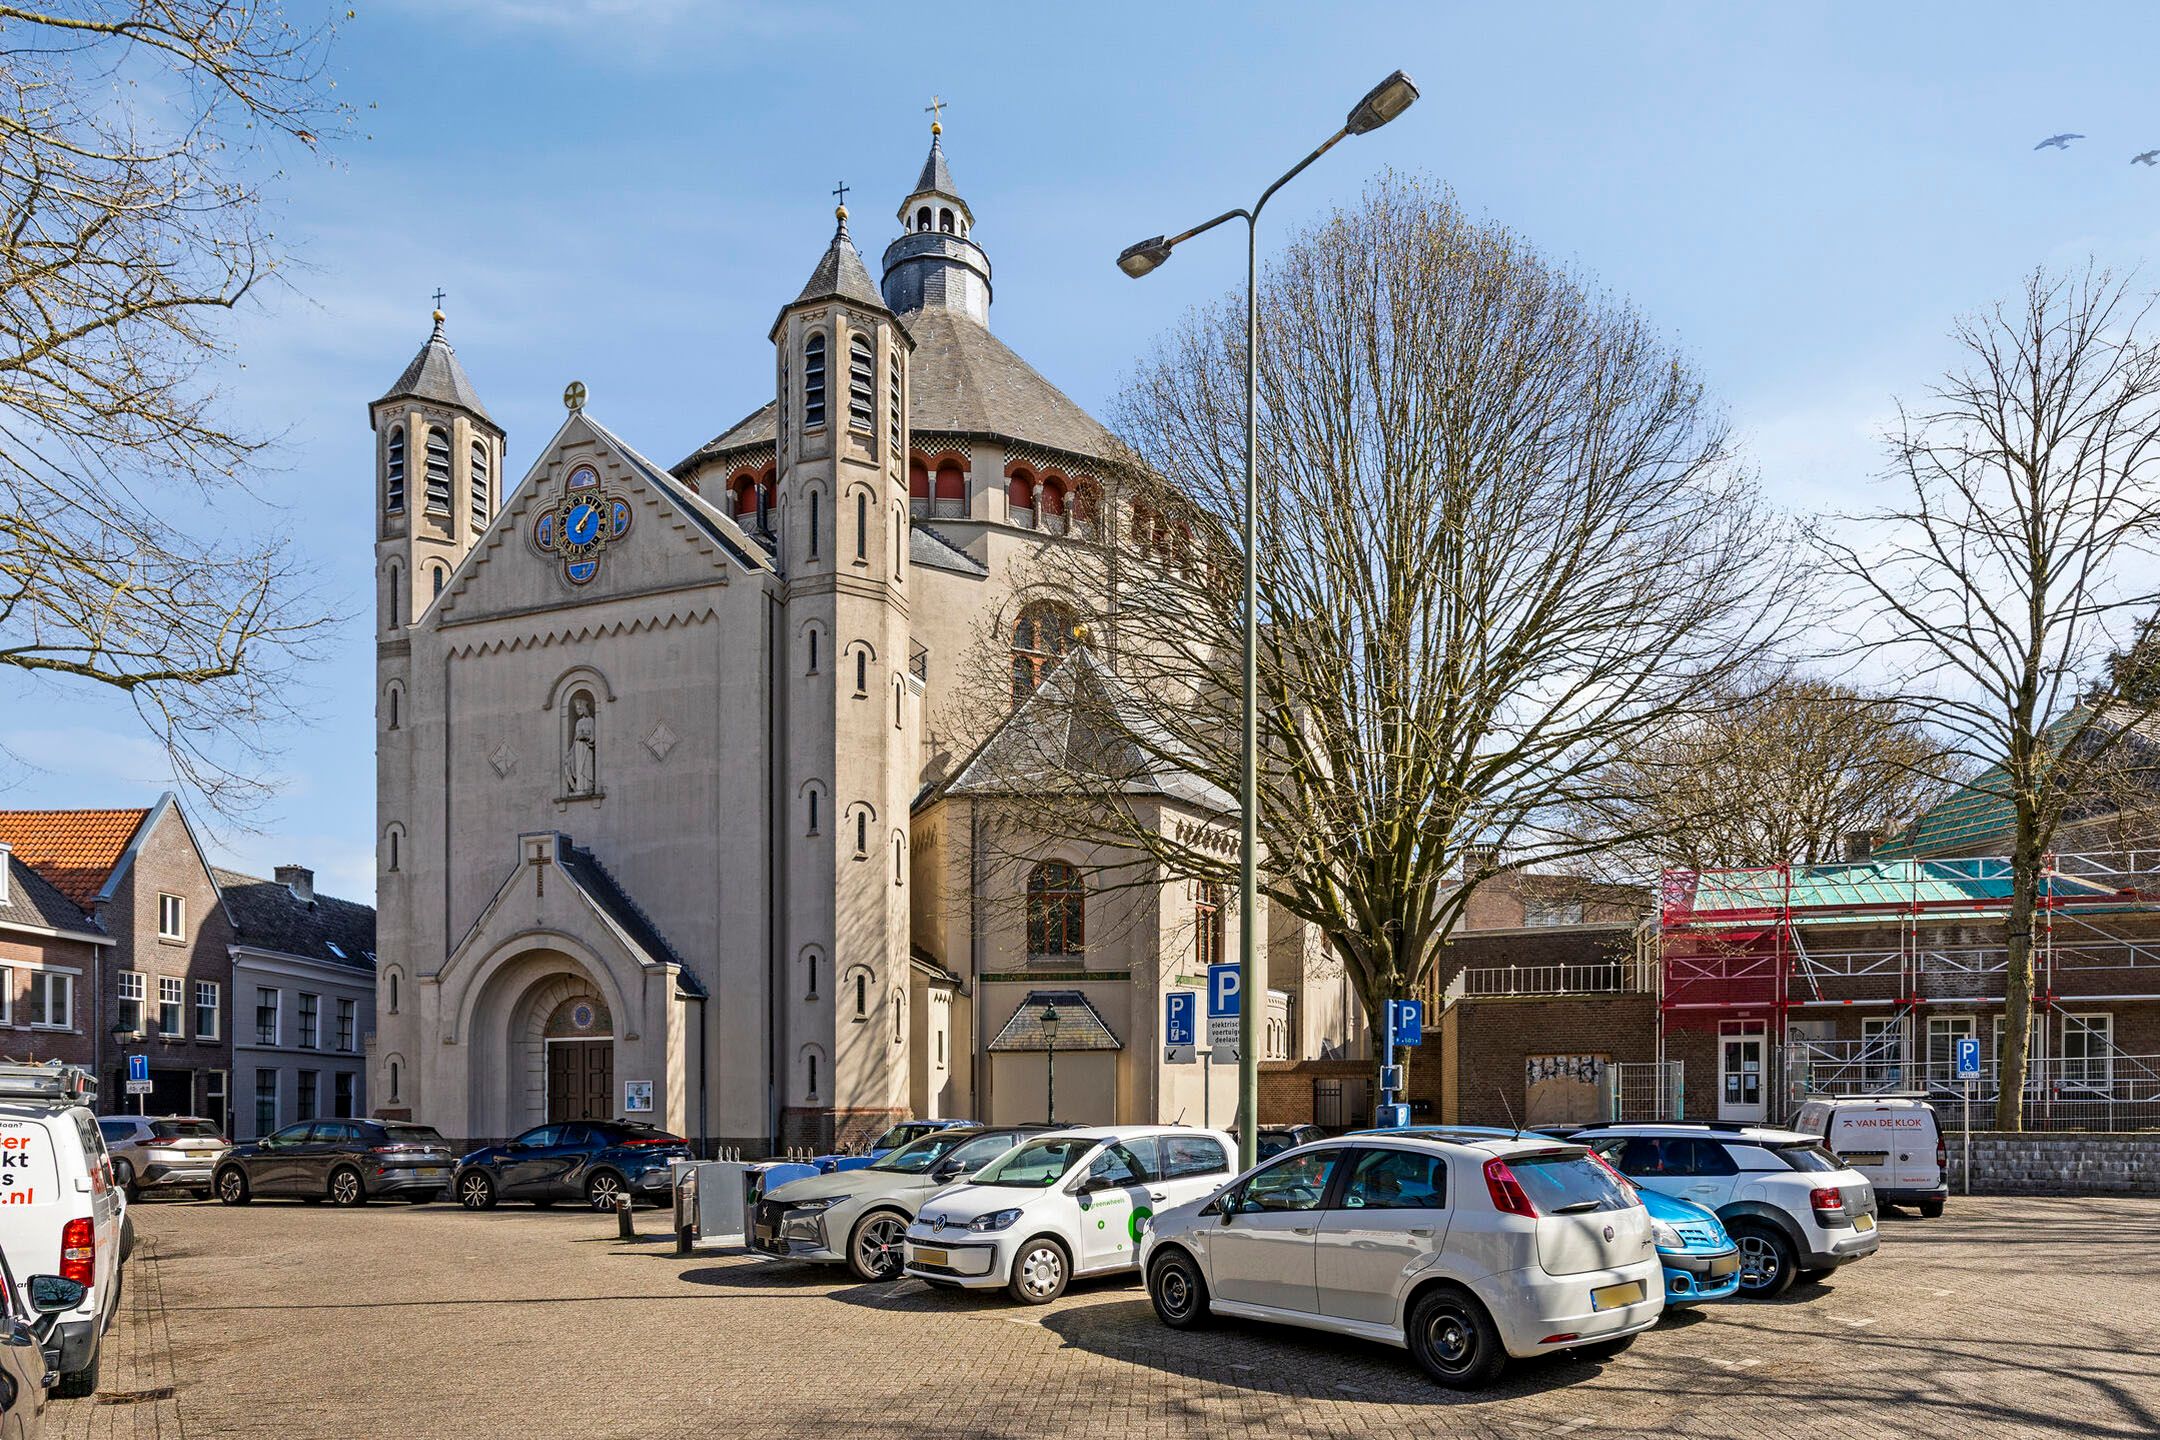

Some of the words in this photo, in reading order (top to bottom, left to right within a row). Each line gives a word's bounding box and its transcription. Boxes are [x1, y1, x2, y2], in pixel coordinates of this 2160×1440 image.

[1218, 971, 1240, 1010] P
[1171, 997, 1184, 1019] P
[1211, 1021, 1238, 1029] elektrisc
[1402, 1006, 1417, 1029] P
[1963, 1042, 1975, 1060] P
[1856, 1119, 1877, 1127] VAN
[1880, 1119, 1893, 1127] DE
[1895, 1119, 1922, 1127] KLOK
[0, 1188, 33, 1204] .nl
